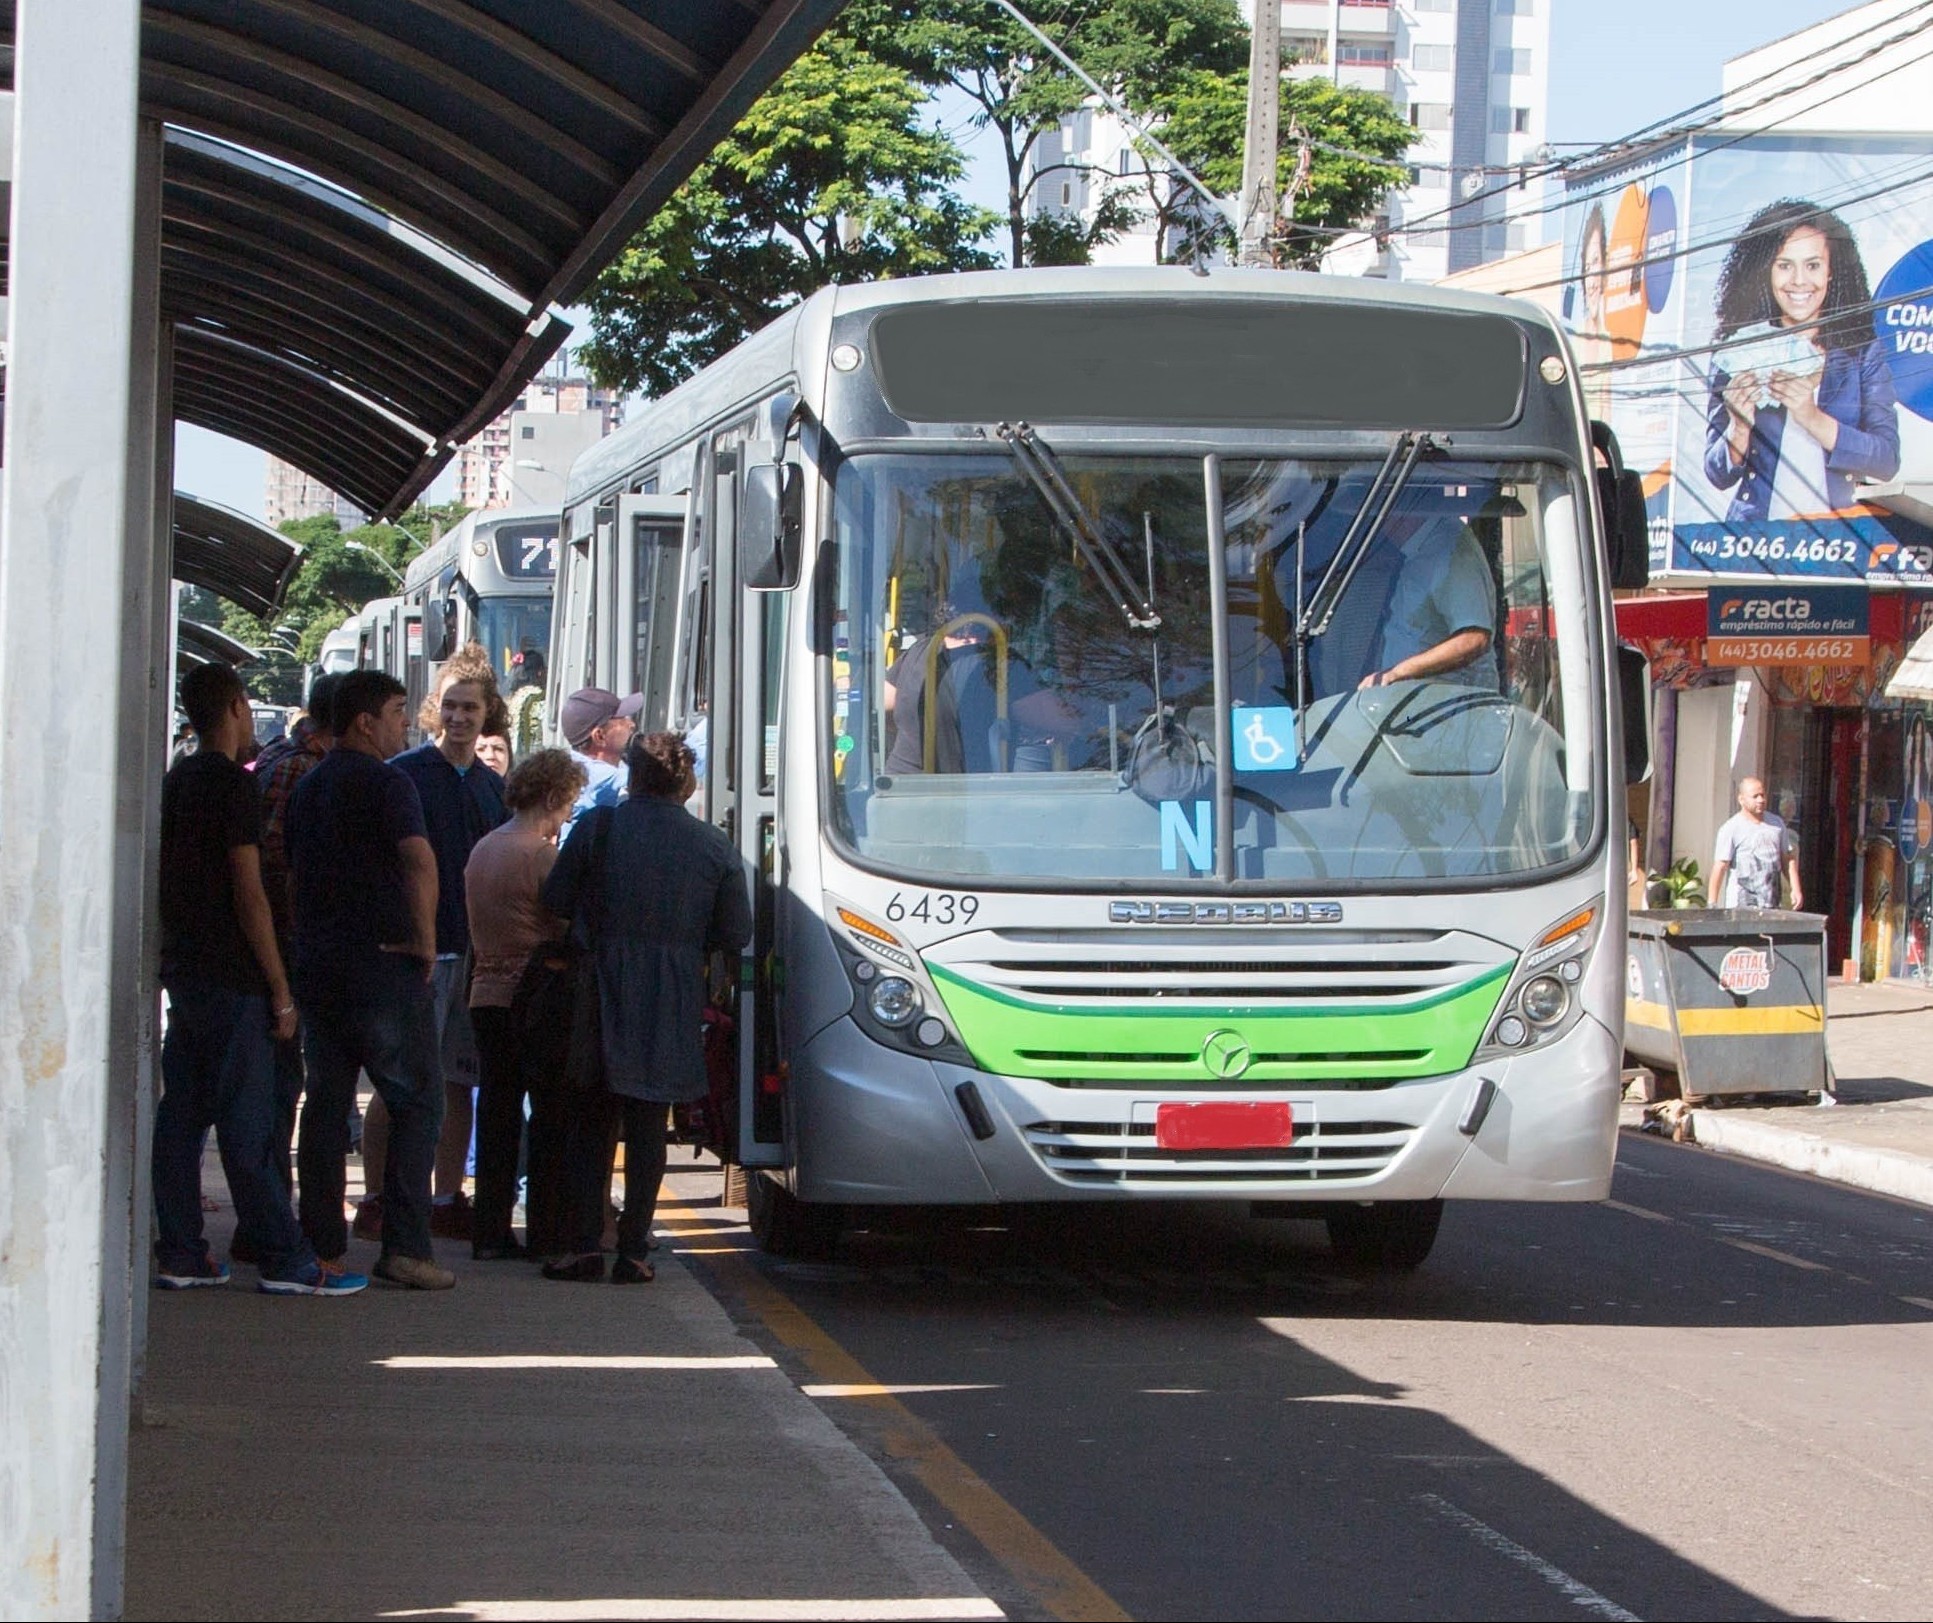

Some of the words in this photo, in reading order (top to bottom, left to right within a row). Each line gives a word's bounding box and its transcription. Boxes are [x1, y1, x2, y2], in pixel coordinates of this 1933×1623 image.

[1690, 539, 1717, 556] (44)
[1719, 535, 1857, 563] 3046.4662
[1743, 597, 1810, 619] facta
[1720, 620, 1784, 632] empréstimo
[1786, 619, 1822, 631] rápido
[1823, 622, 1830, 630] e
[1831, 619, 1855, 631] fácil
[1160, 800, 1212, 871] N
[885, 892, 979, 925] 6439
[1108, 900, 1343, 924] NEOBUS
